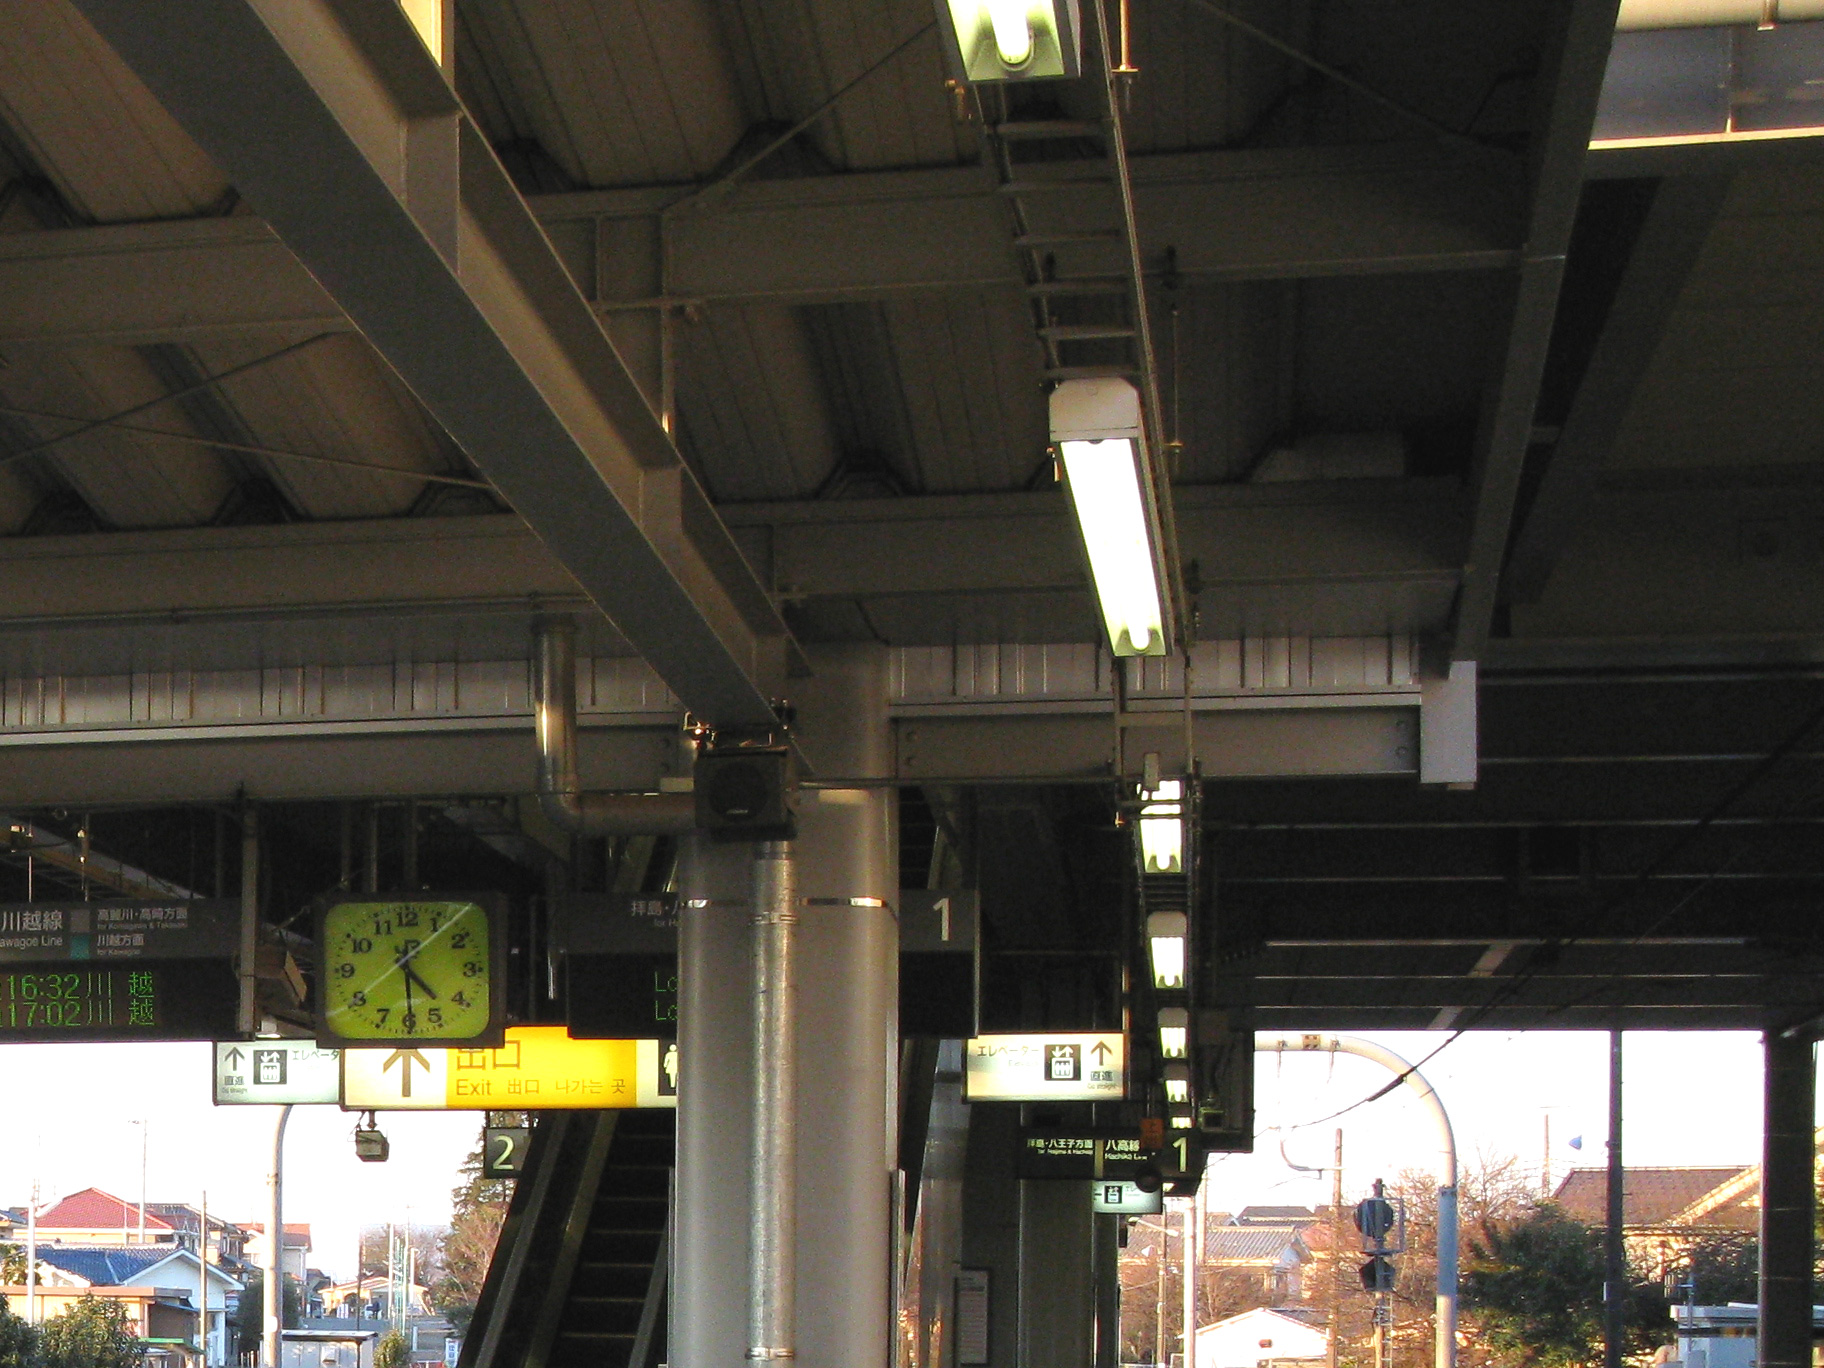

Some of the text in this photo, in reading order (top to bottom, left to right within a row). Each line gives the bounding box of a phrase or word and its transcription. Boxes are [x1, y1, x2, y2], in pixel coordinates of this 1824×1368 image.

[397, 911, 419, 927] 12
[430, 917, 439, 932] 1
[932, 897, 950, 941] 1
[374, 920, 392, 935] 11
[352, 937, 372, 953] 10
[451, 933, 466, 949] 2
[341, 963, 355, 978] 9
[463, 961, 477, 977] 3
[7, 972, 81, 999] 16:32
[451, 991, 466, 1004] 4
[7, 1001, 81, 1027] 17:02
[377, 1008, 390, 1024] 7
[402, 1012, 416, 1029] 6
[428, 1007, 442, 1023] 5
[977, 1045, 1040, 1057] エレベーター
[456, 1079, 491, 1096] Exit
[507, 1079, 540, 1095] 出口
[555, 1079, 626, 1095] 나가는 곳
[492, 1135, 514, 1170] 2
[1172, 1137, 1187, 1172] 1
